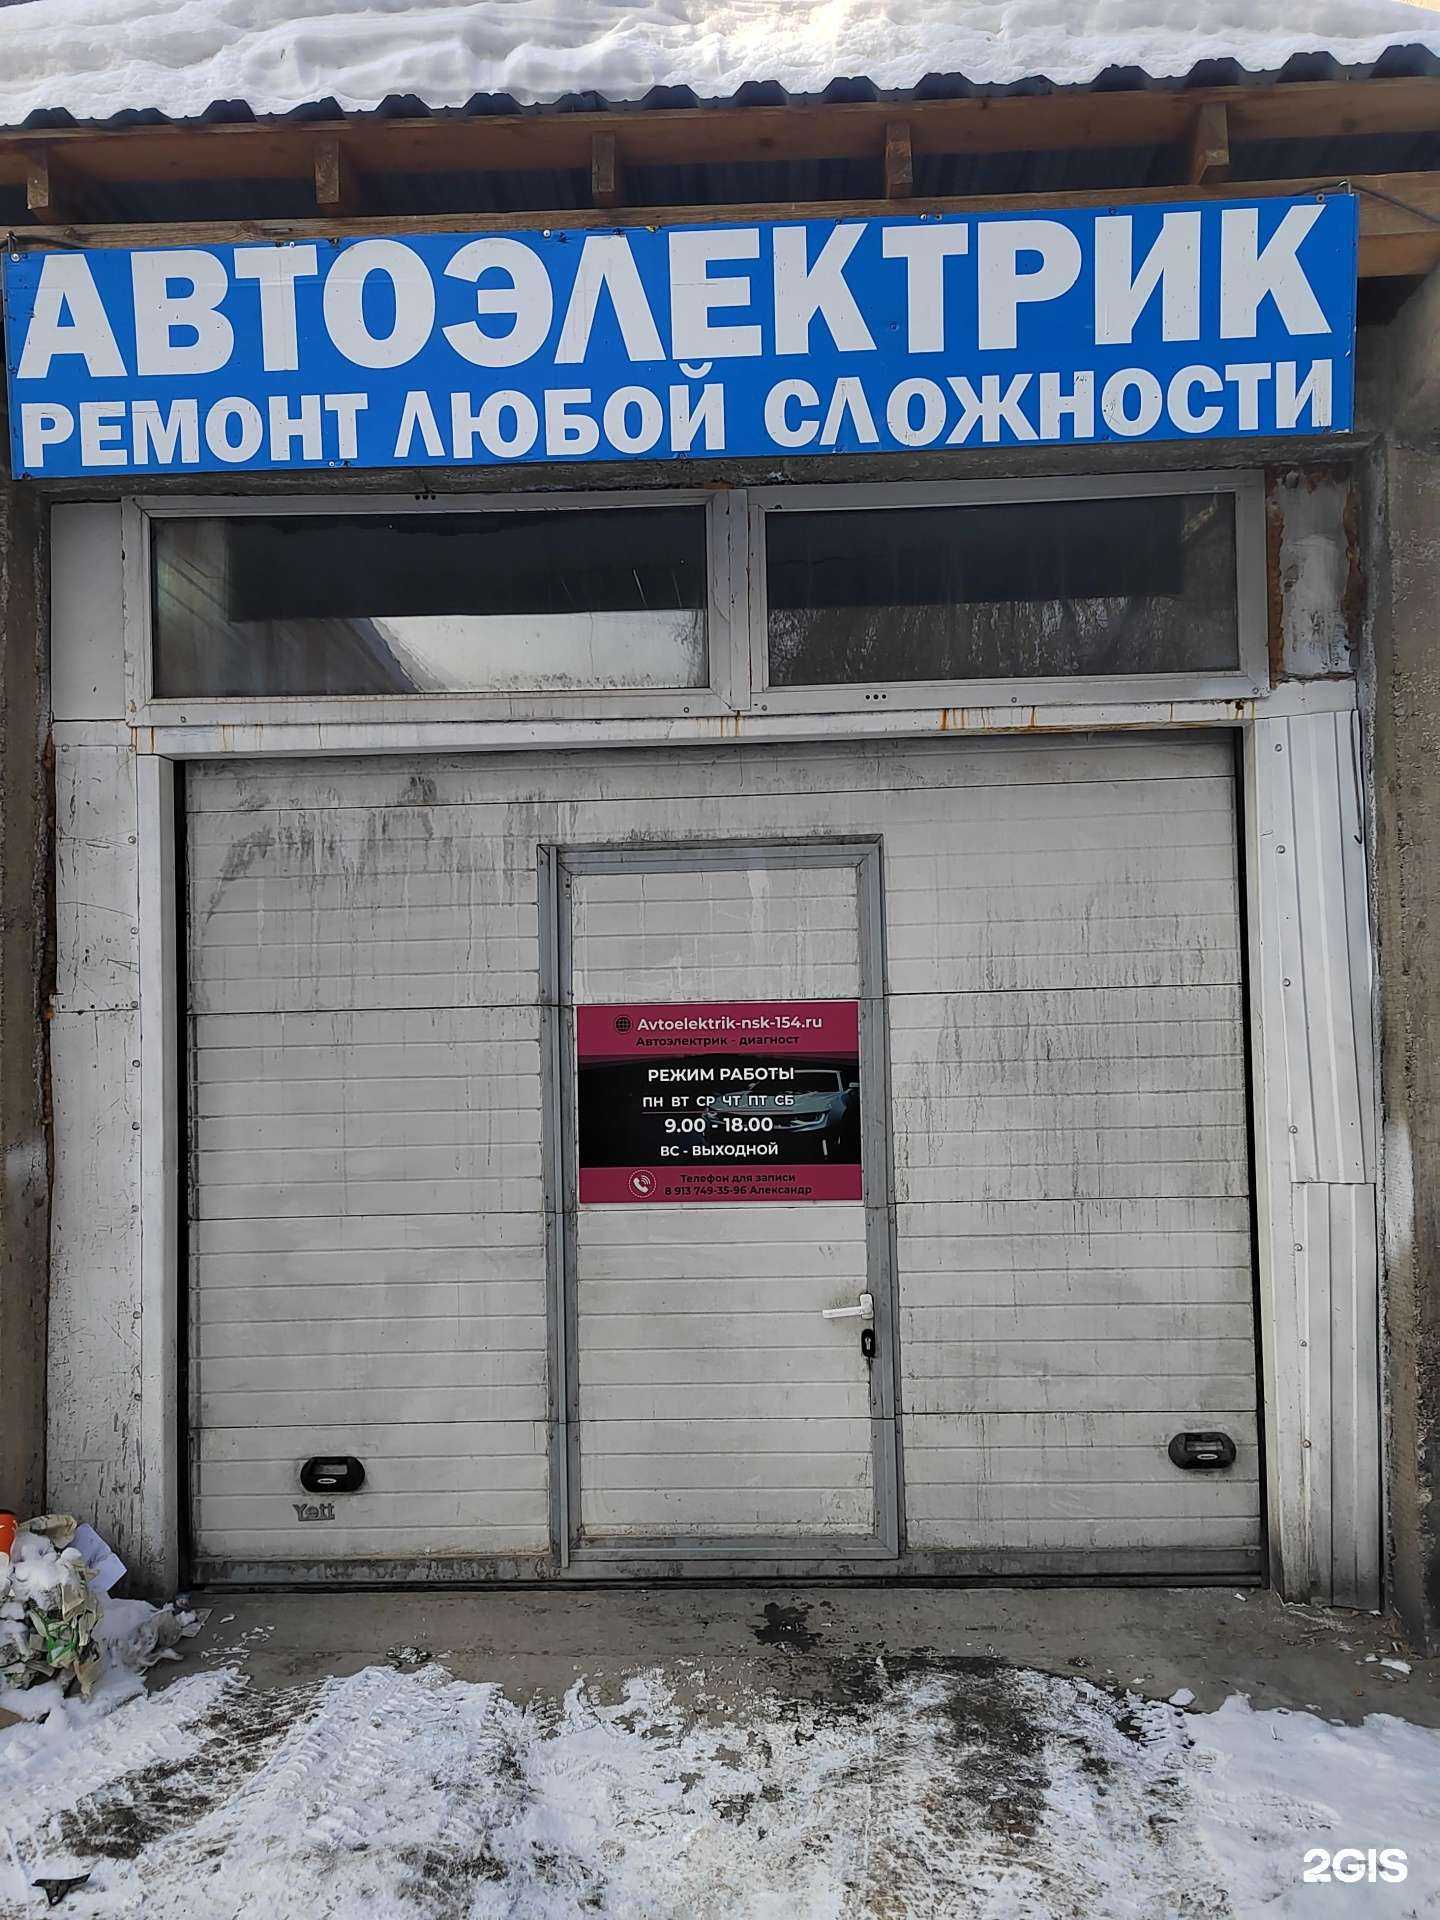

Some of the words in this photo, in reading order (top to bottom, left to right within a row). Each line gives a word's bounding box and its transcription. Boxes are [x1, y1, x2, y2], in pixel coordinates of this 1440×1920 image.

[17, 204, 1332, 379] АВТОЭЛЕКТРИК
[21, 392, 367, 467] РЕМОНТ
[394, 362, 725, 459] ЛЮБОЙ
[764, 359, 1333, 447] СЛОЖНОСТИ
[637, 1016, 822, 1031] Avtoelektrik-nsk-154.ru
[636, 1036, 728, 1047] Автоэлектрик
[739, 1036, 800, 1046] диагност
[648, 1068, 714, 1082] РЕЖИМ
[720, 1067, 795, 1081] РАБОТЫ
[643, 1096, 664, 1108] ПН
[671, 1096, 689, 1107] ВТ
[696, 1096, 715, 1107] СР
[722, 1095, 741, 1106] ЧТ
[748, 1095, 767, 1106] ПТ
[774, 1095, 794, 1106] СБ
[664, 1118, 706, 1133] 9.00
[723, 1117, 774, 1132] 18.00
[660, 1145, 680, 1157] ВС
[692, 1142, 779, 1158] ВЫХОДНОЙ
[680, 1174, 729, 1184] Телефон
[732, 1174, 752, 1184] для
[755, 1174, 796, 1183] записи
[664, 1187, 672, 1196] 8
[674, 1186, 691, 1195] 913
[750, 1185, 812, 1196] Александр
